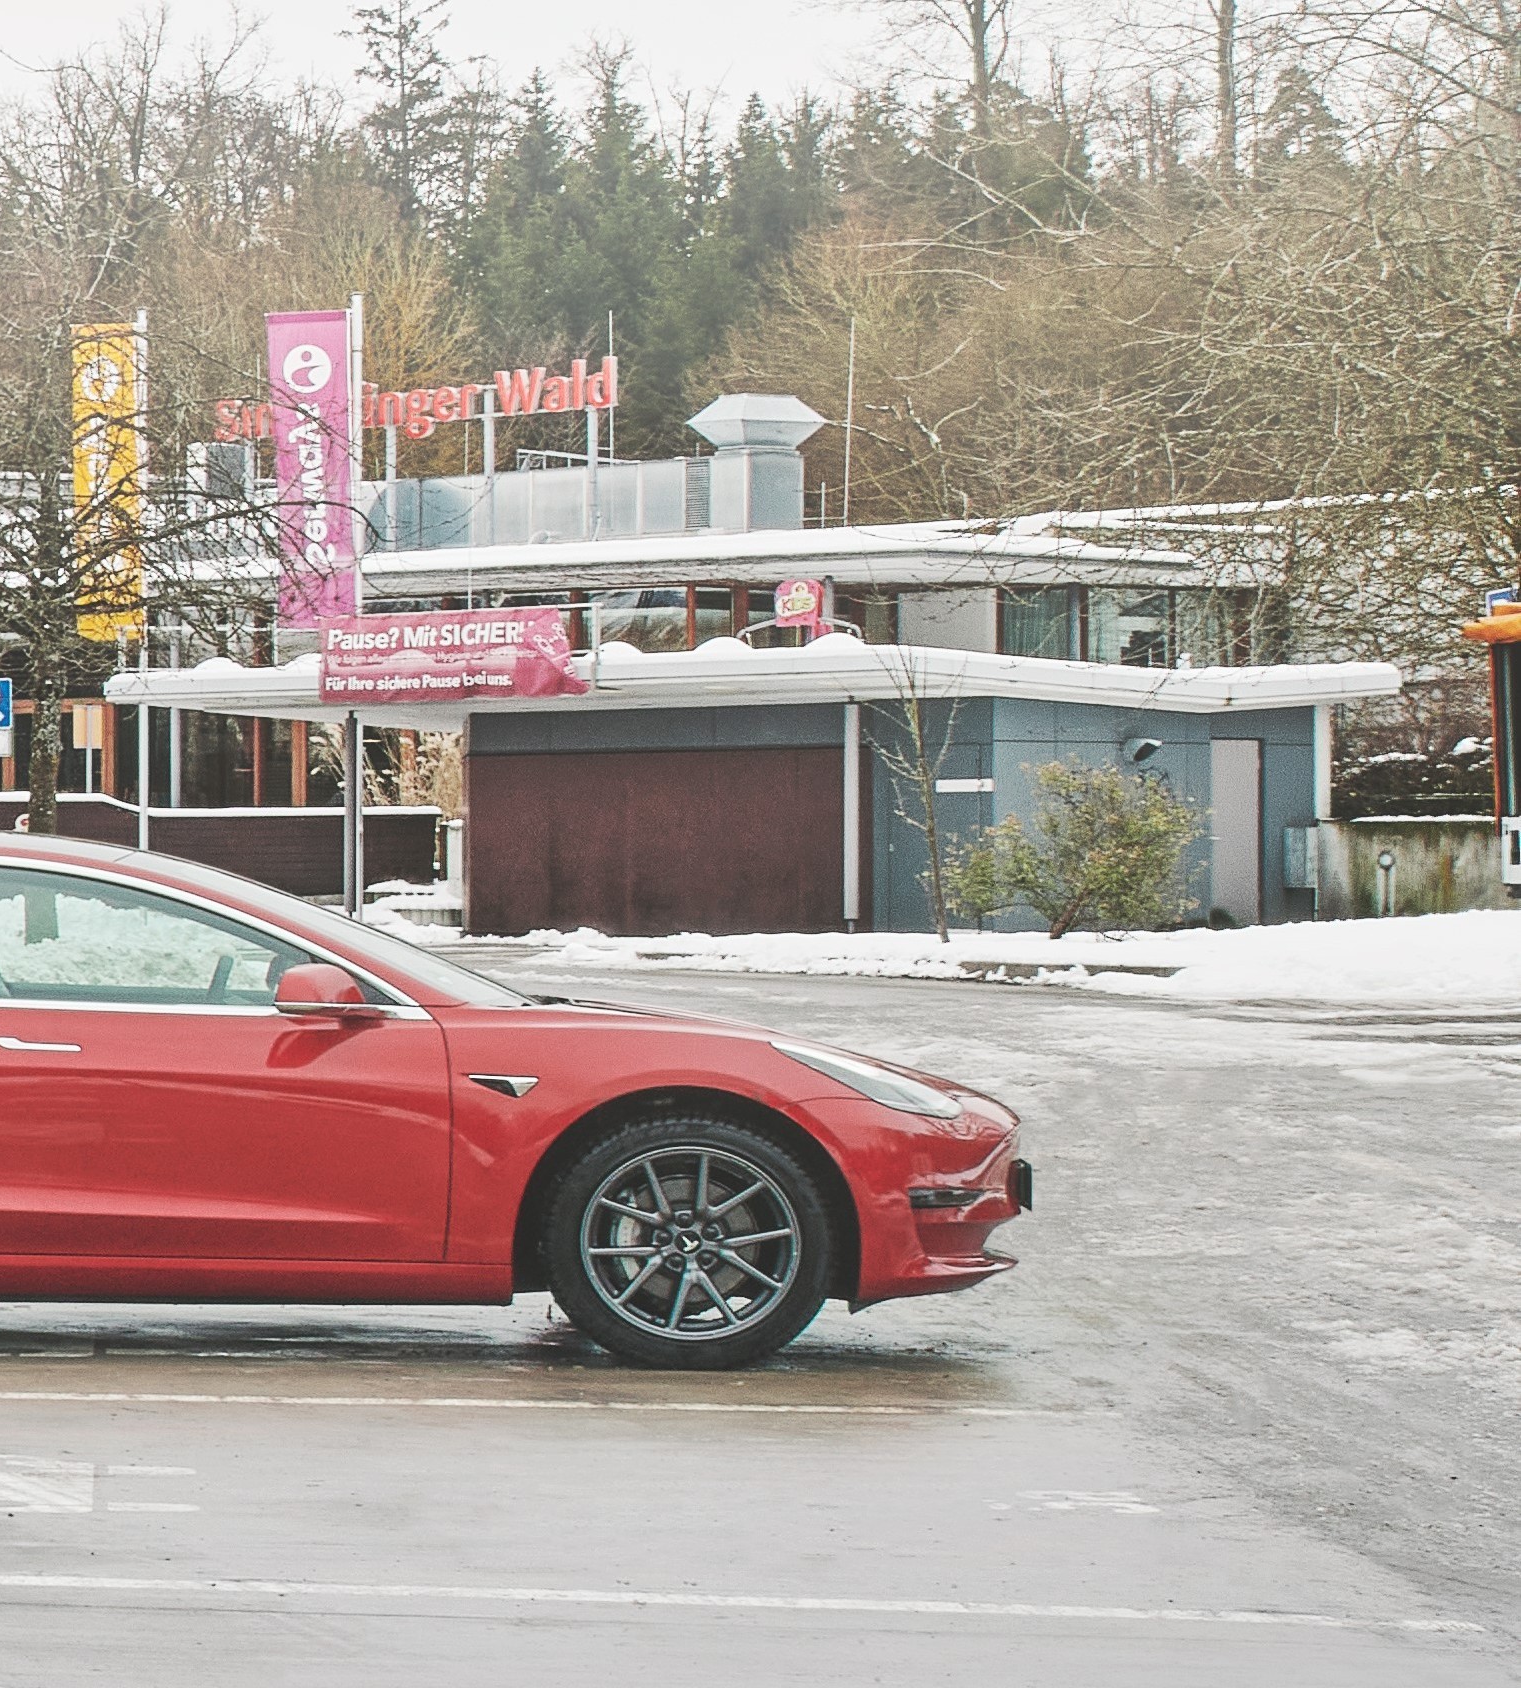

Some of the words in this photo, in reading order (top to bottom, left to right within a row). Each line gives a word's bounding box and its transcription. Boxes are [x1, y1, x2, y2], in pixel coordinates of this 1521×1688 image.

[494, 356, 618, 414] Wald
[327, 626, 400, 650] Pause?
[403, 624, 437, 648] Mit
[325, 676, 346, 691] Für
[348, 676, 375, 691] Ihre
[422, 673, 461, 689] Pause
[462, 671, 486, 686] bei
[487, 674, 513, 687] uns.
